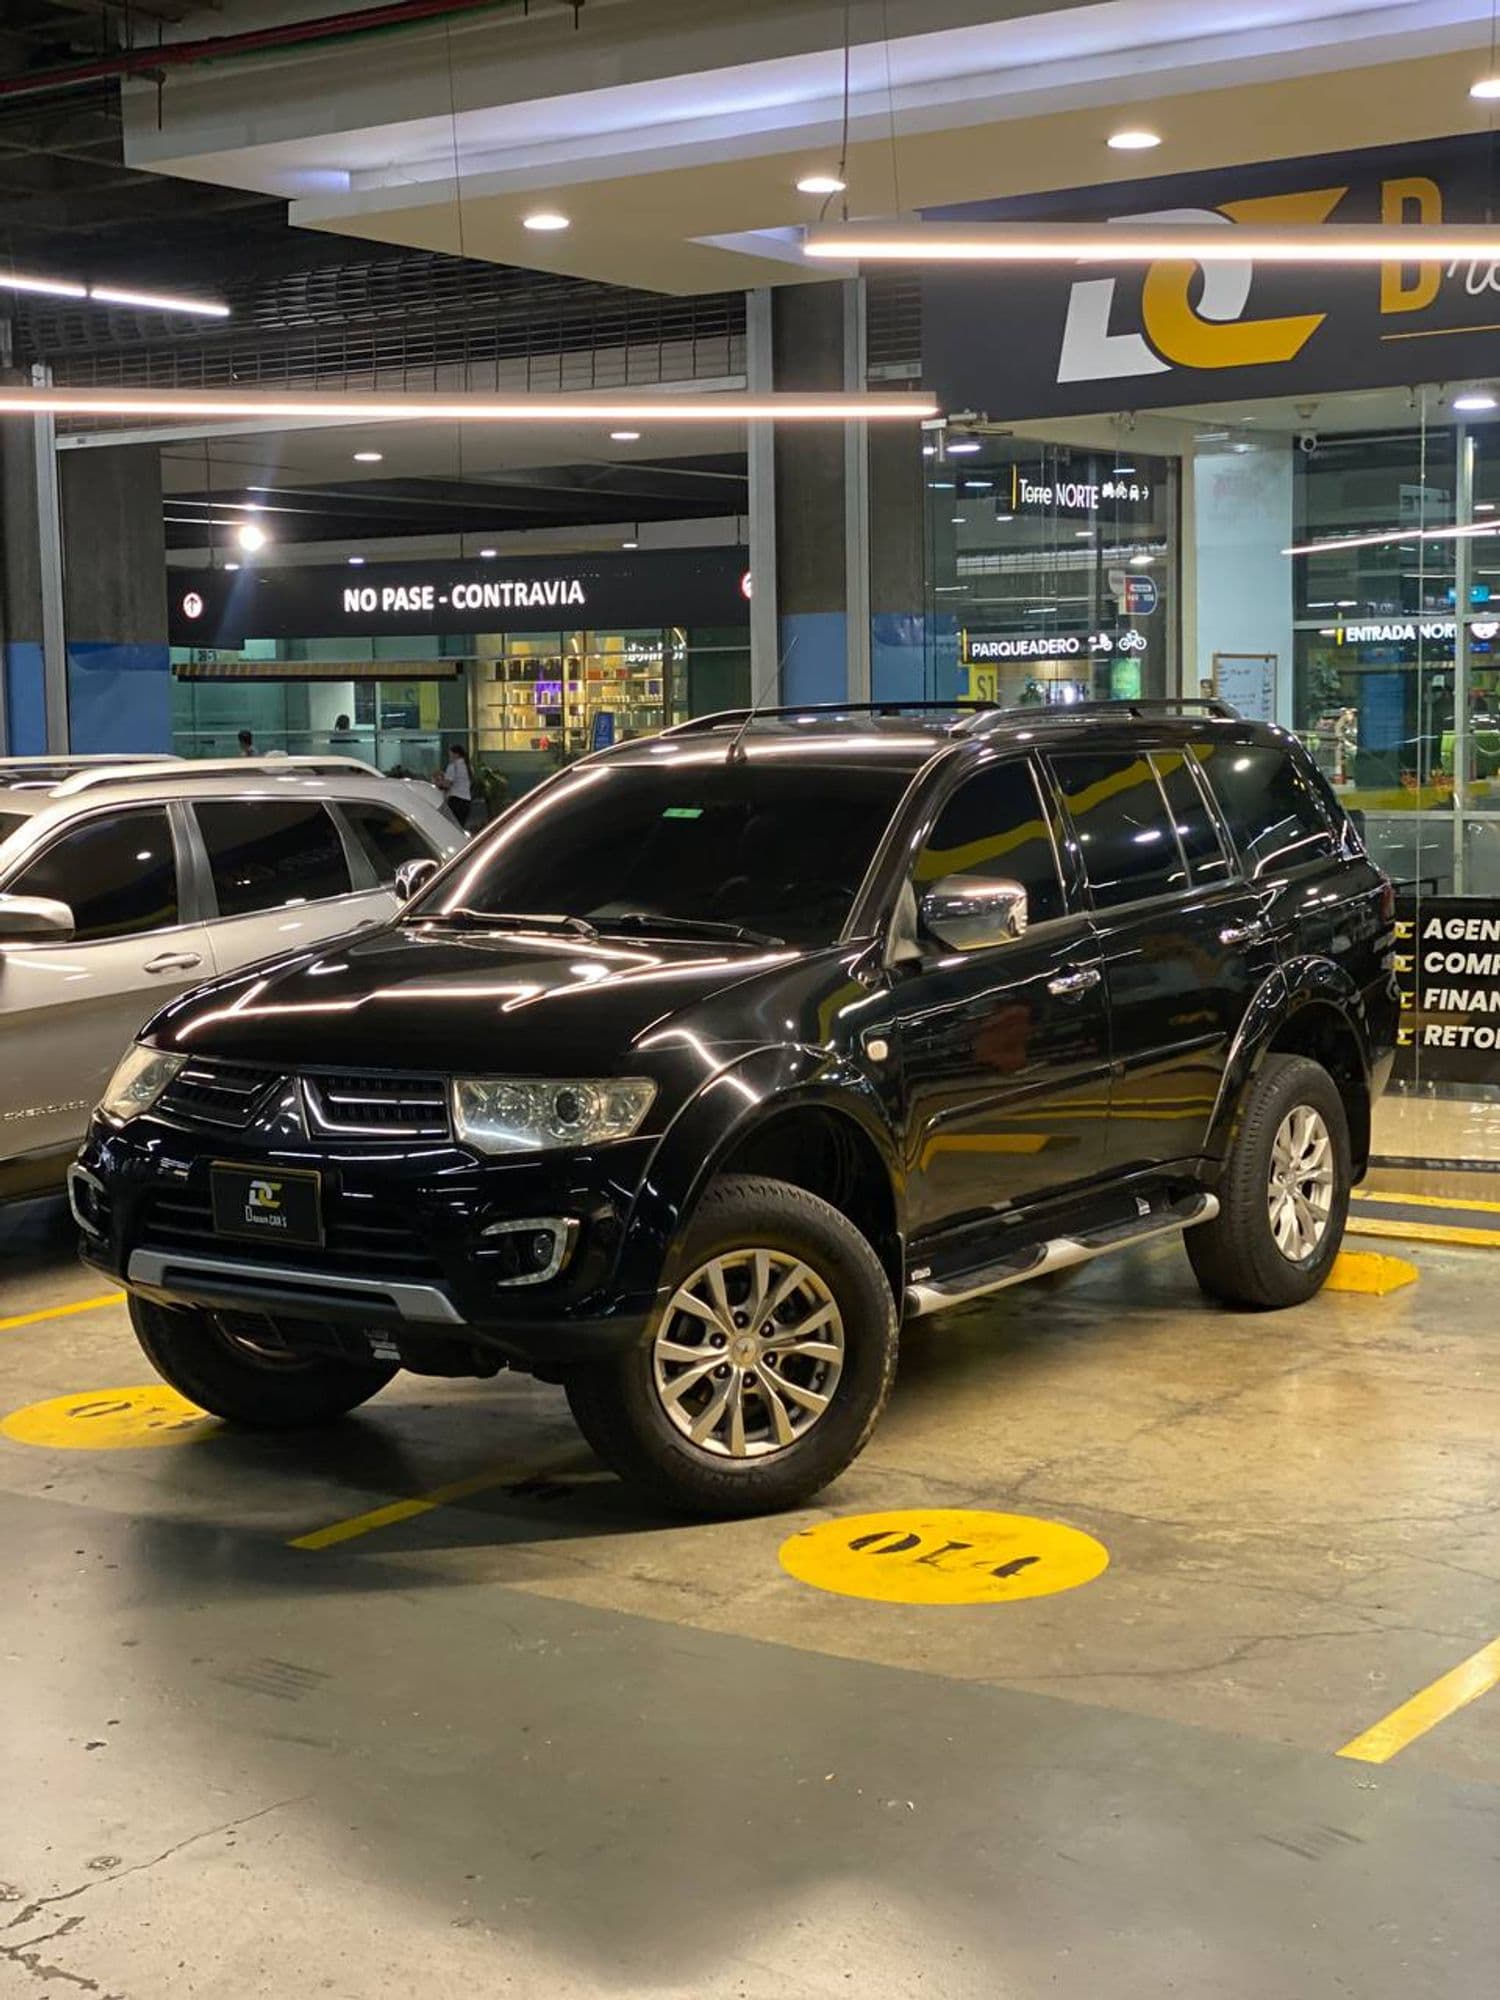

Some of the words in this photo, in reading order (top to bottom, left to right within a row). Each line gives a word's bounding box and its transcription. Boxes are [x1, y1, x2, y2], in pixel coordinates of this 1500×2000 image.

[1018, 478, 1053, 505] Torre
[1055, 482, 1099, 510] NORTE
[344, 587, 377, 613] NO
[382, 586, 435, 611] PASE
[452, 580, 586, 609] CONTRAVIA
[1345, 623, 1417, 643] ENTRADA
[971, 637, 1080, 658] PARQUEADERO
[1422, 917, 1500, 941] AGEN
[1423, 1024, 1500, 1050] RETO
